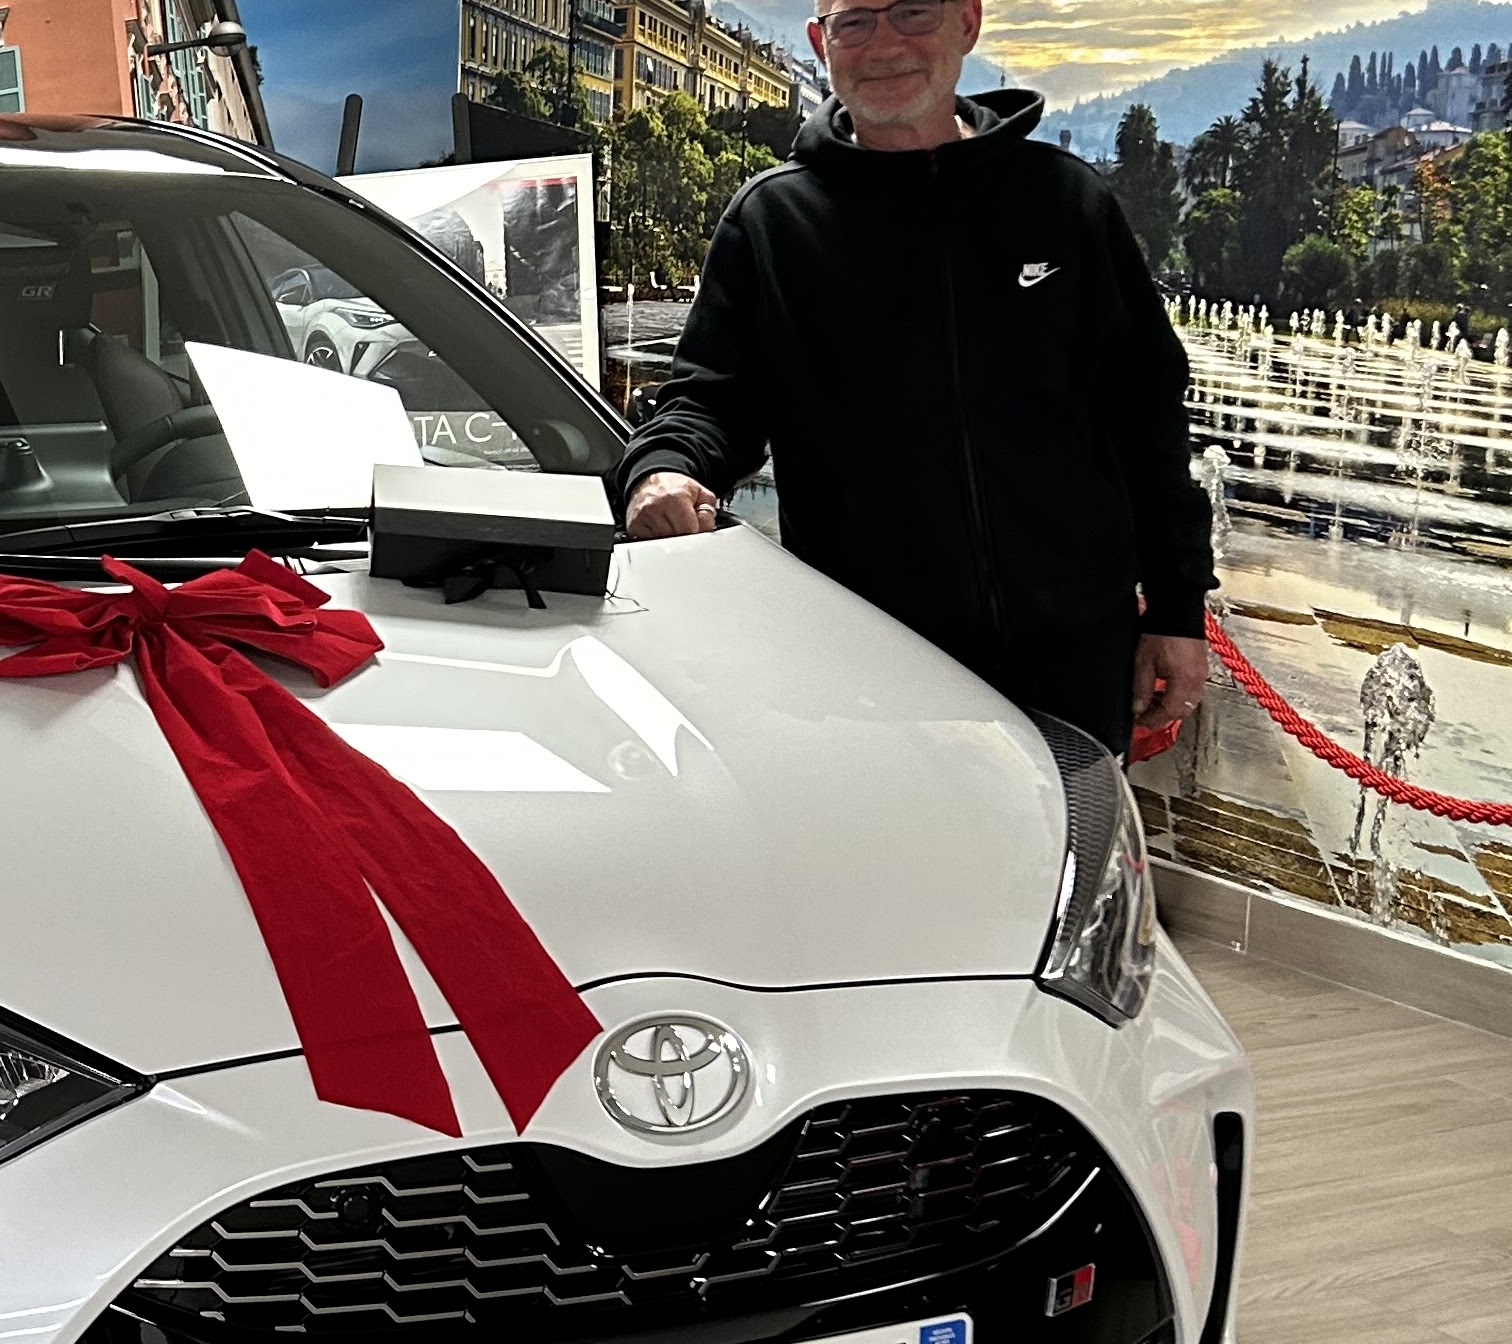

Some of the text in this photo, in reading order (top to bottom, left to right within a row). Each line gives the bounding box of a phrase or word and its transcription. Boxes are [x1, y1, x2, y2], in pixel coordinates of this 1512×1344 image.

[21, 286, 53, 297] GR
[413, 412, 518, 446] TA C-
